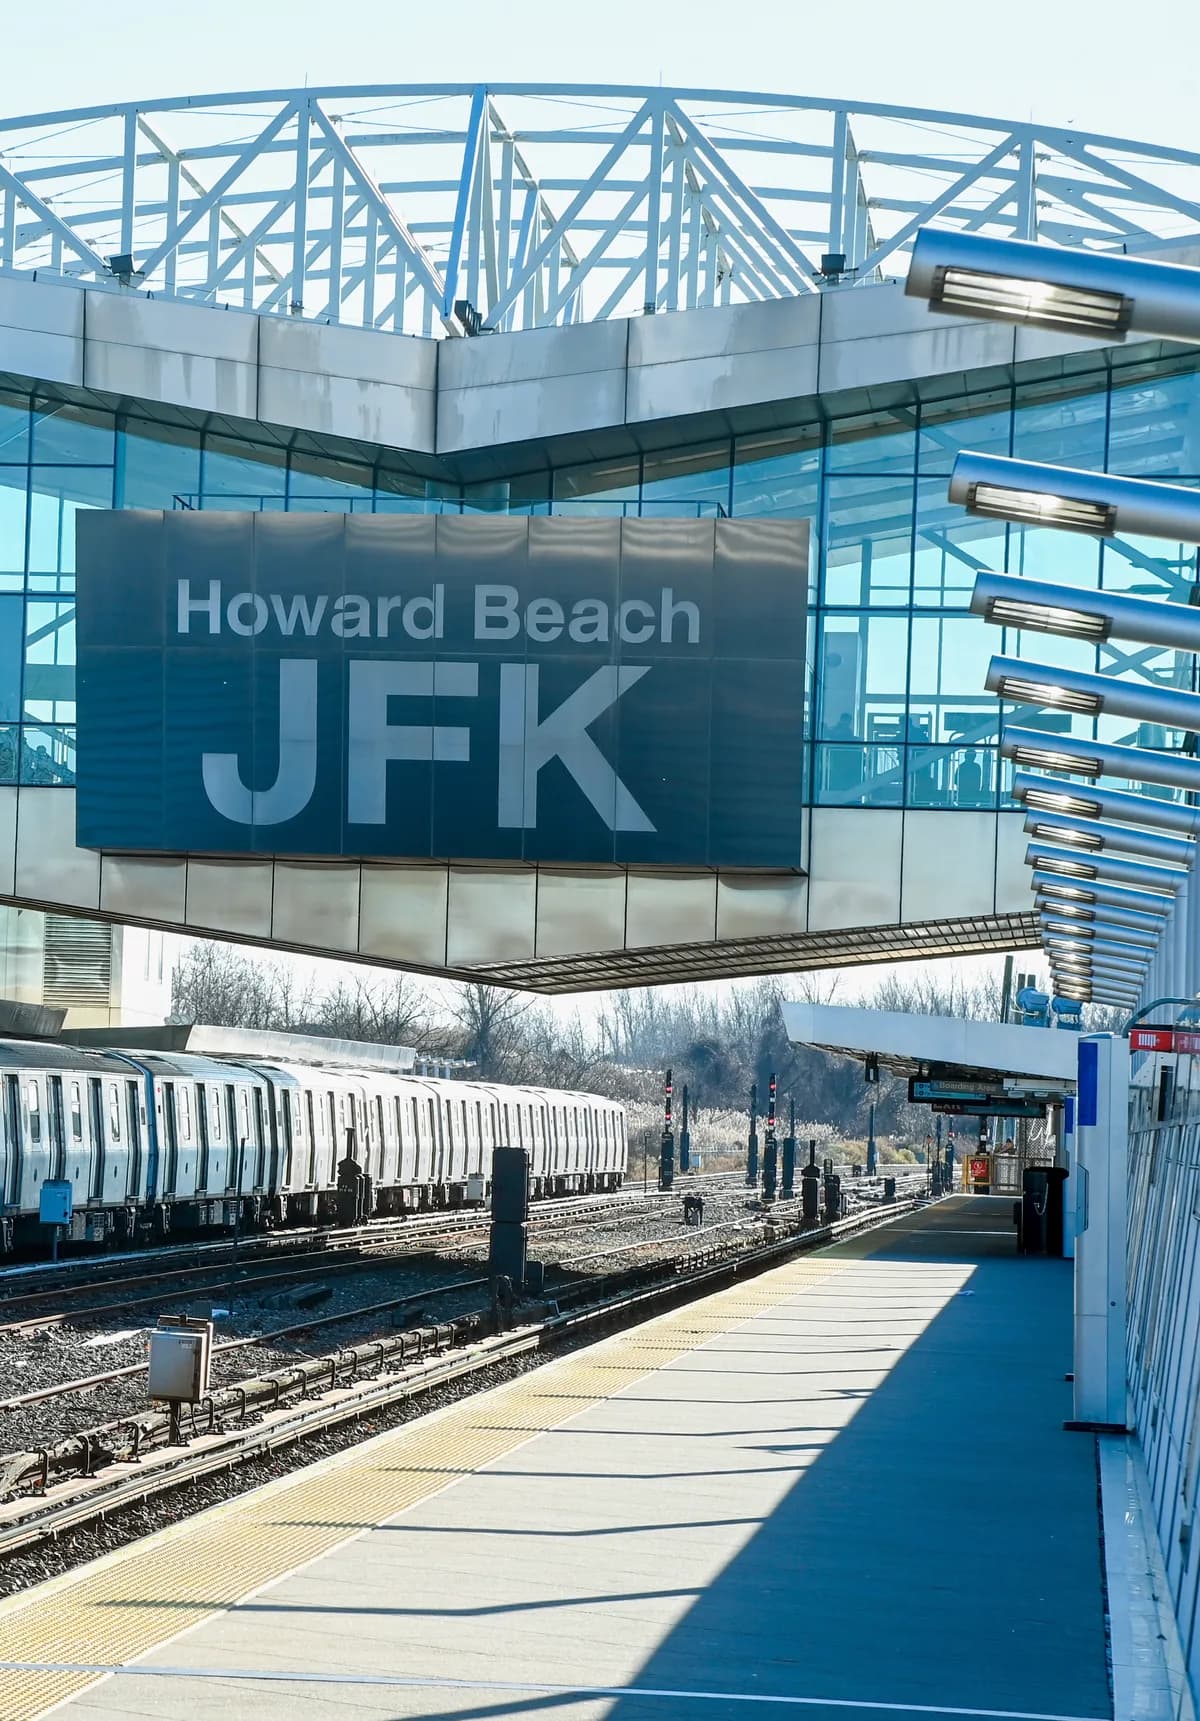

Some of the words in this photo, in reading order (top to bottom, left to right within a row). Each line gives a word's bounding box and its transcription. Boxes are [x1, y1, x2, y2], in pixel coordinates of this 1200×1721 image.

[176, 578, 445, 640] Howard
[473, 583, 701, 644] Beach
[201, 657, 658, 833] JFK
